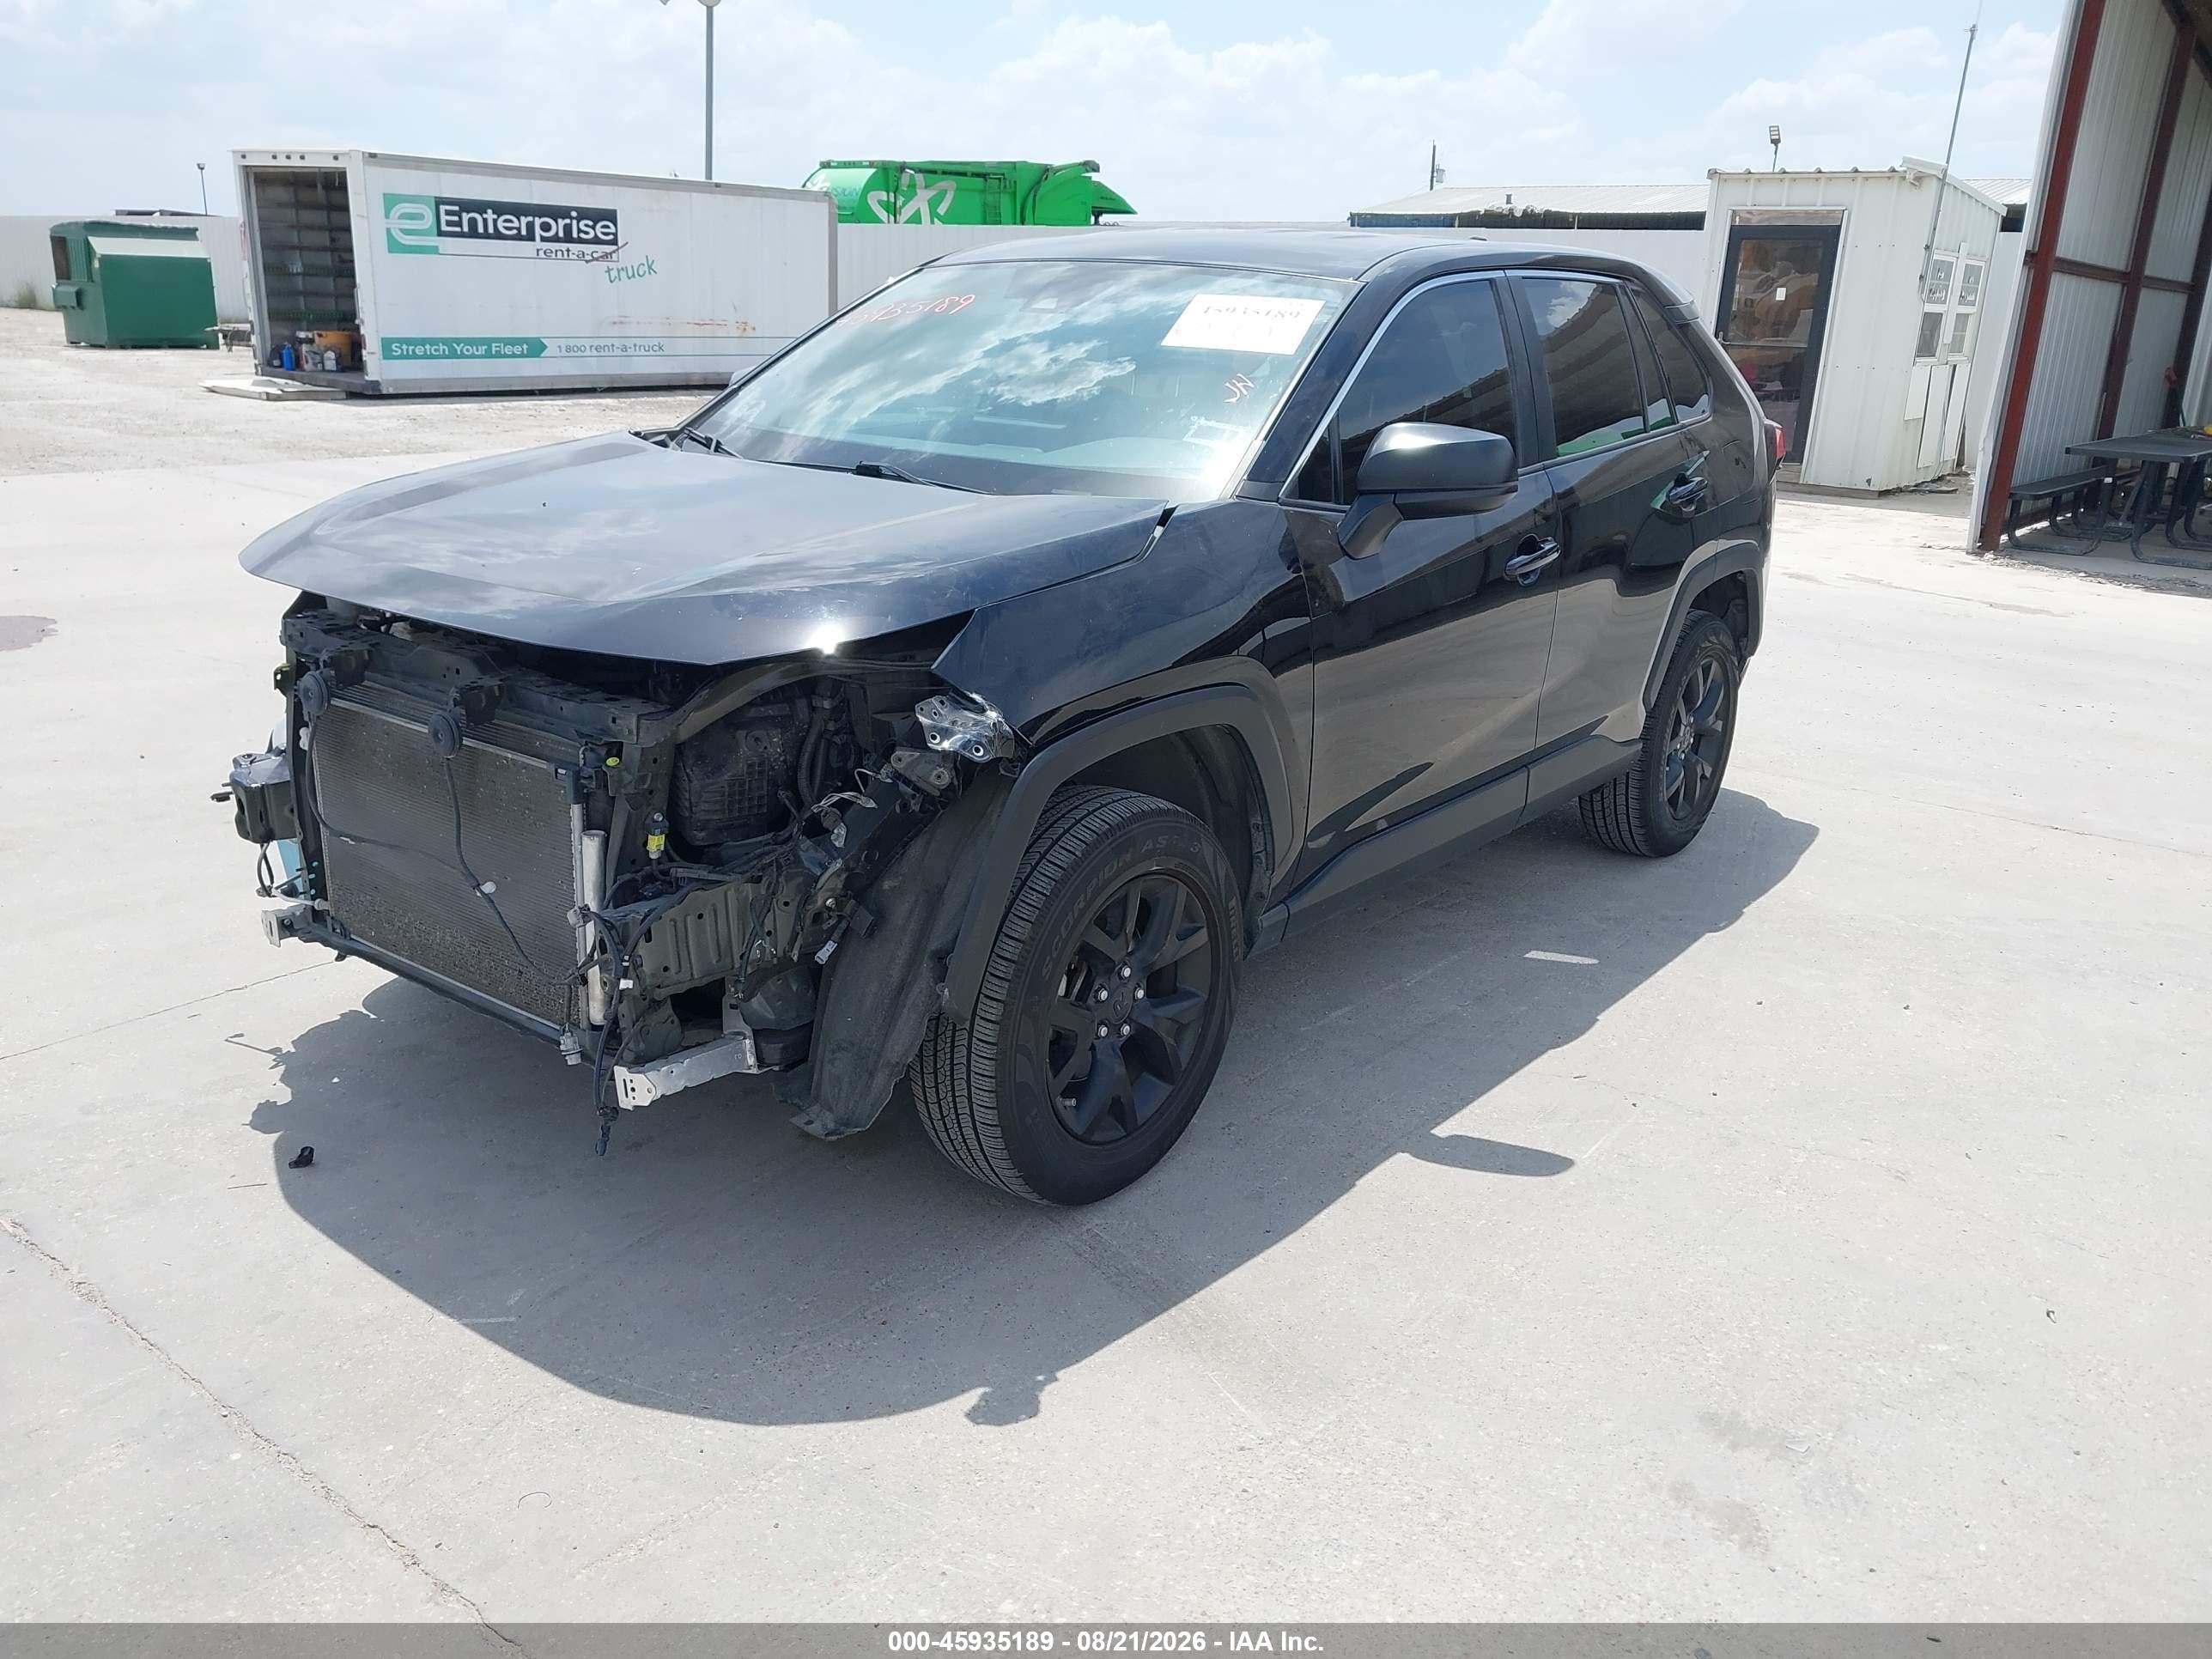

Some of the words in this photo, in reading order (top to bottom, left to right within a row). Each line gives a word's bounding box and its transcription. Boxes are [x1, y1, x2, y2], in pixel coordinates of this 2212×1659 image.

[439, 204, 617, 243] Enterprise
[536, 246, 618, 260] rent-a-car
[605, 255, 658, 283] truck
[392, 343, 448, 356] Stretch
[453, 343, 488, 356] Your
[492, 342, 529, 355] Fleet
[565, 345, 586, 354] 800
[590, 342, 665, 354] rent-a-truck
